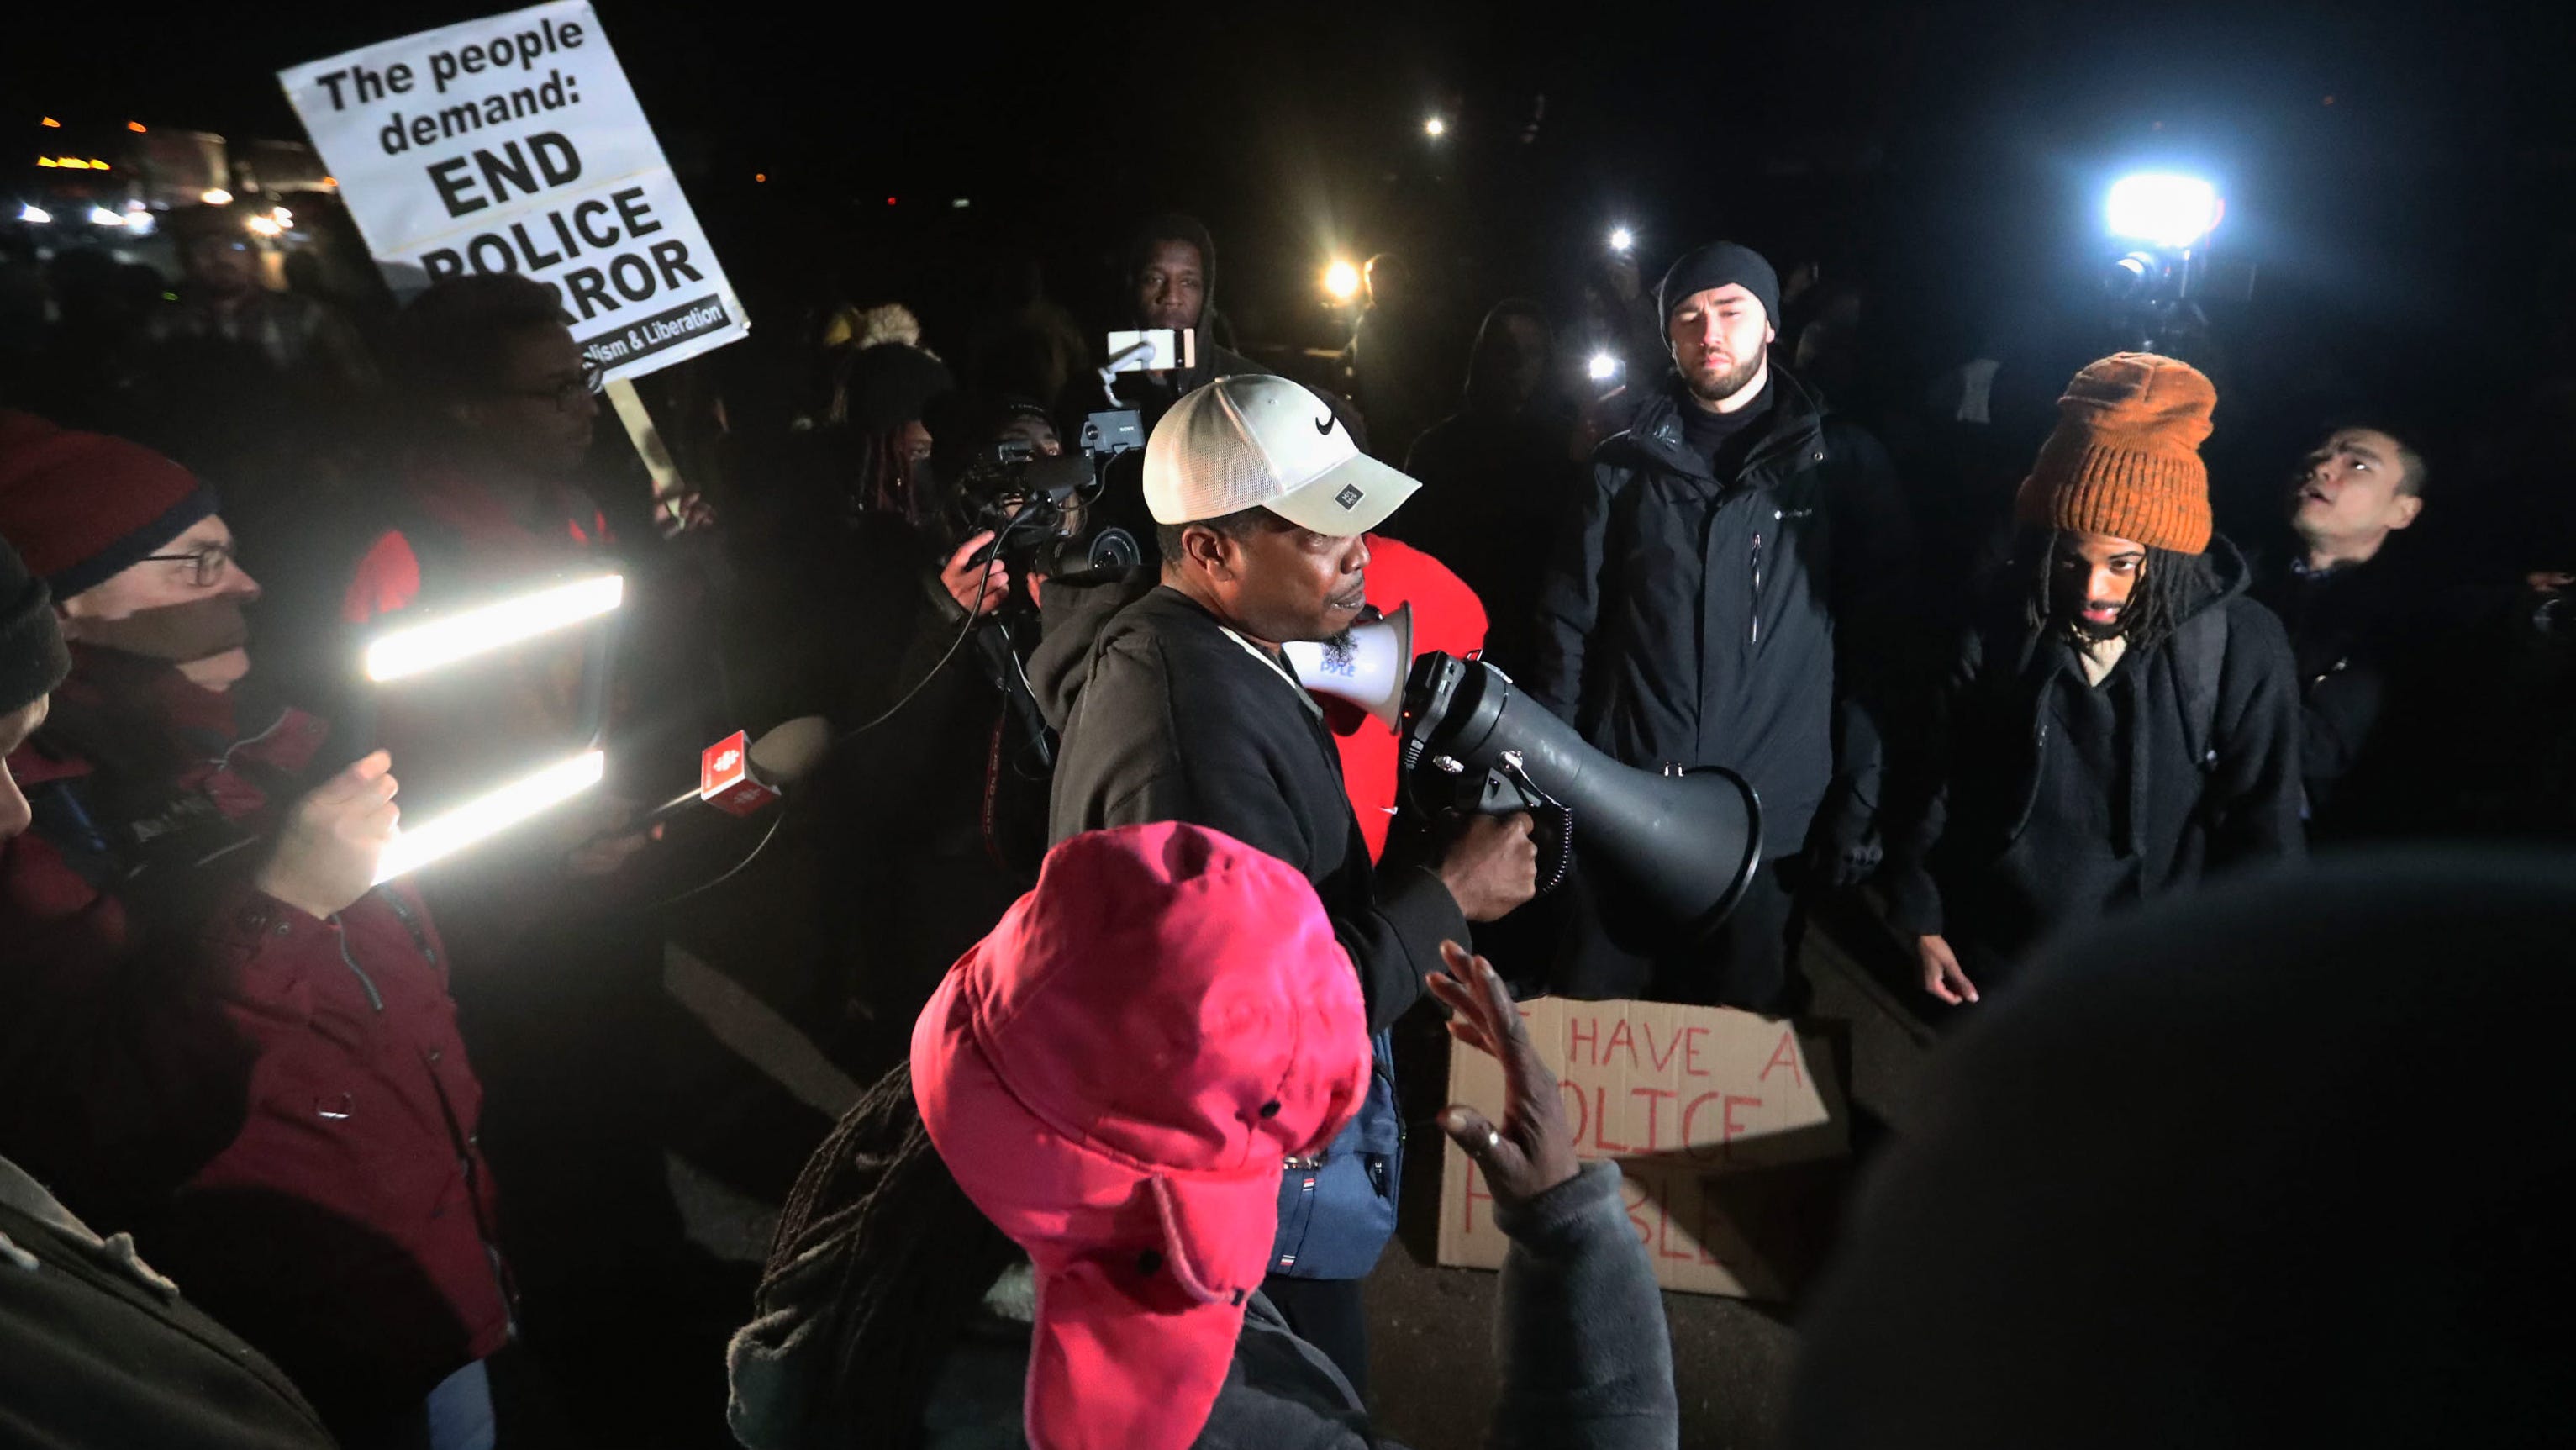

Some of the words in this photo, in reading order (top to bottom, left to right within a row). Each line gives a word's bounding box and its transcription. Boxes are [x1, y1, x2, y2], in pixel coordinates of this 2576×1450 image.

[315, 63, 414, 111] The
[429, 18, 584, 93] people
[380, 69, 580, 156] demand:
[425, 131, 582, 219] END
[627, 330, 645, 351] &
[642, 305, 724, 345] Liberation
[1569, 1016, 1711, 1076] HAVE
[1759, 1031, 1804, 1089] A
